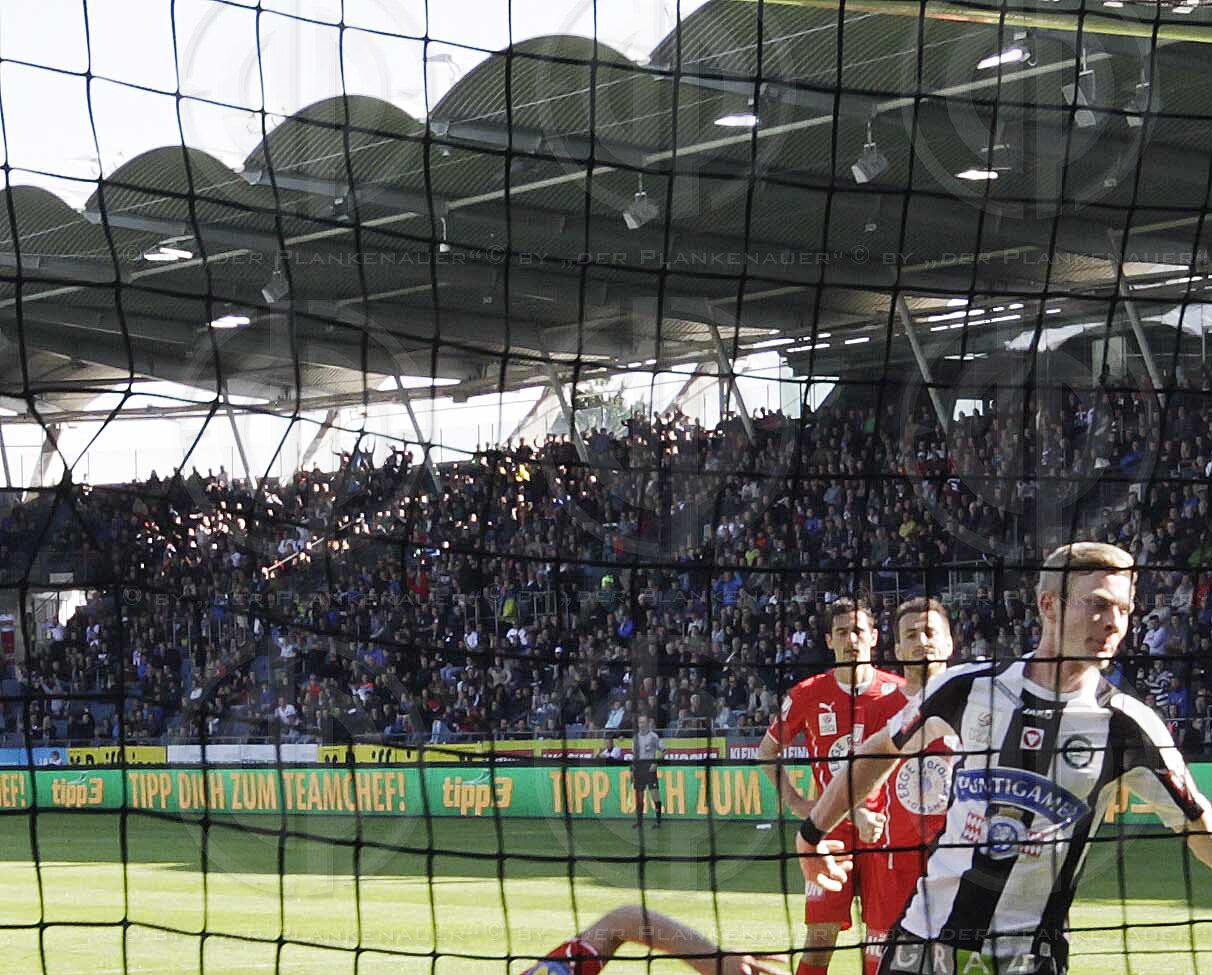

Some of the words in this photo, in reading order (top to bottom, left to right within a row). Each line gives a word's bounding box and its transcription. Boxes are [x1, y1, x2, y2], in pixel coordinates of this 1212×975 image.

[128, 773, 172, 809] TIPP
[231, 773, 277, 811] ZUM
[443, 776, 513, 816] tipp3
[550, 770, 609, 814] TIPP
[694, 769, 762, 816] ZUM
